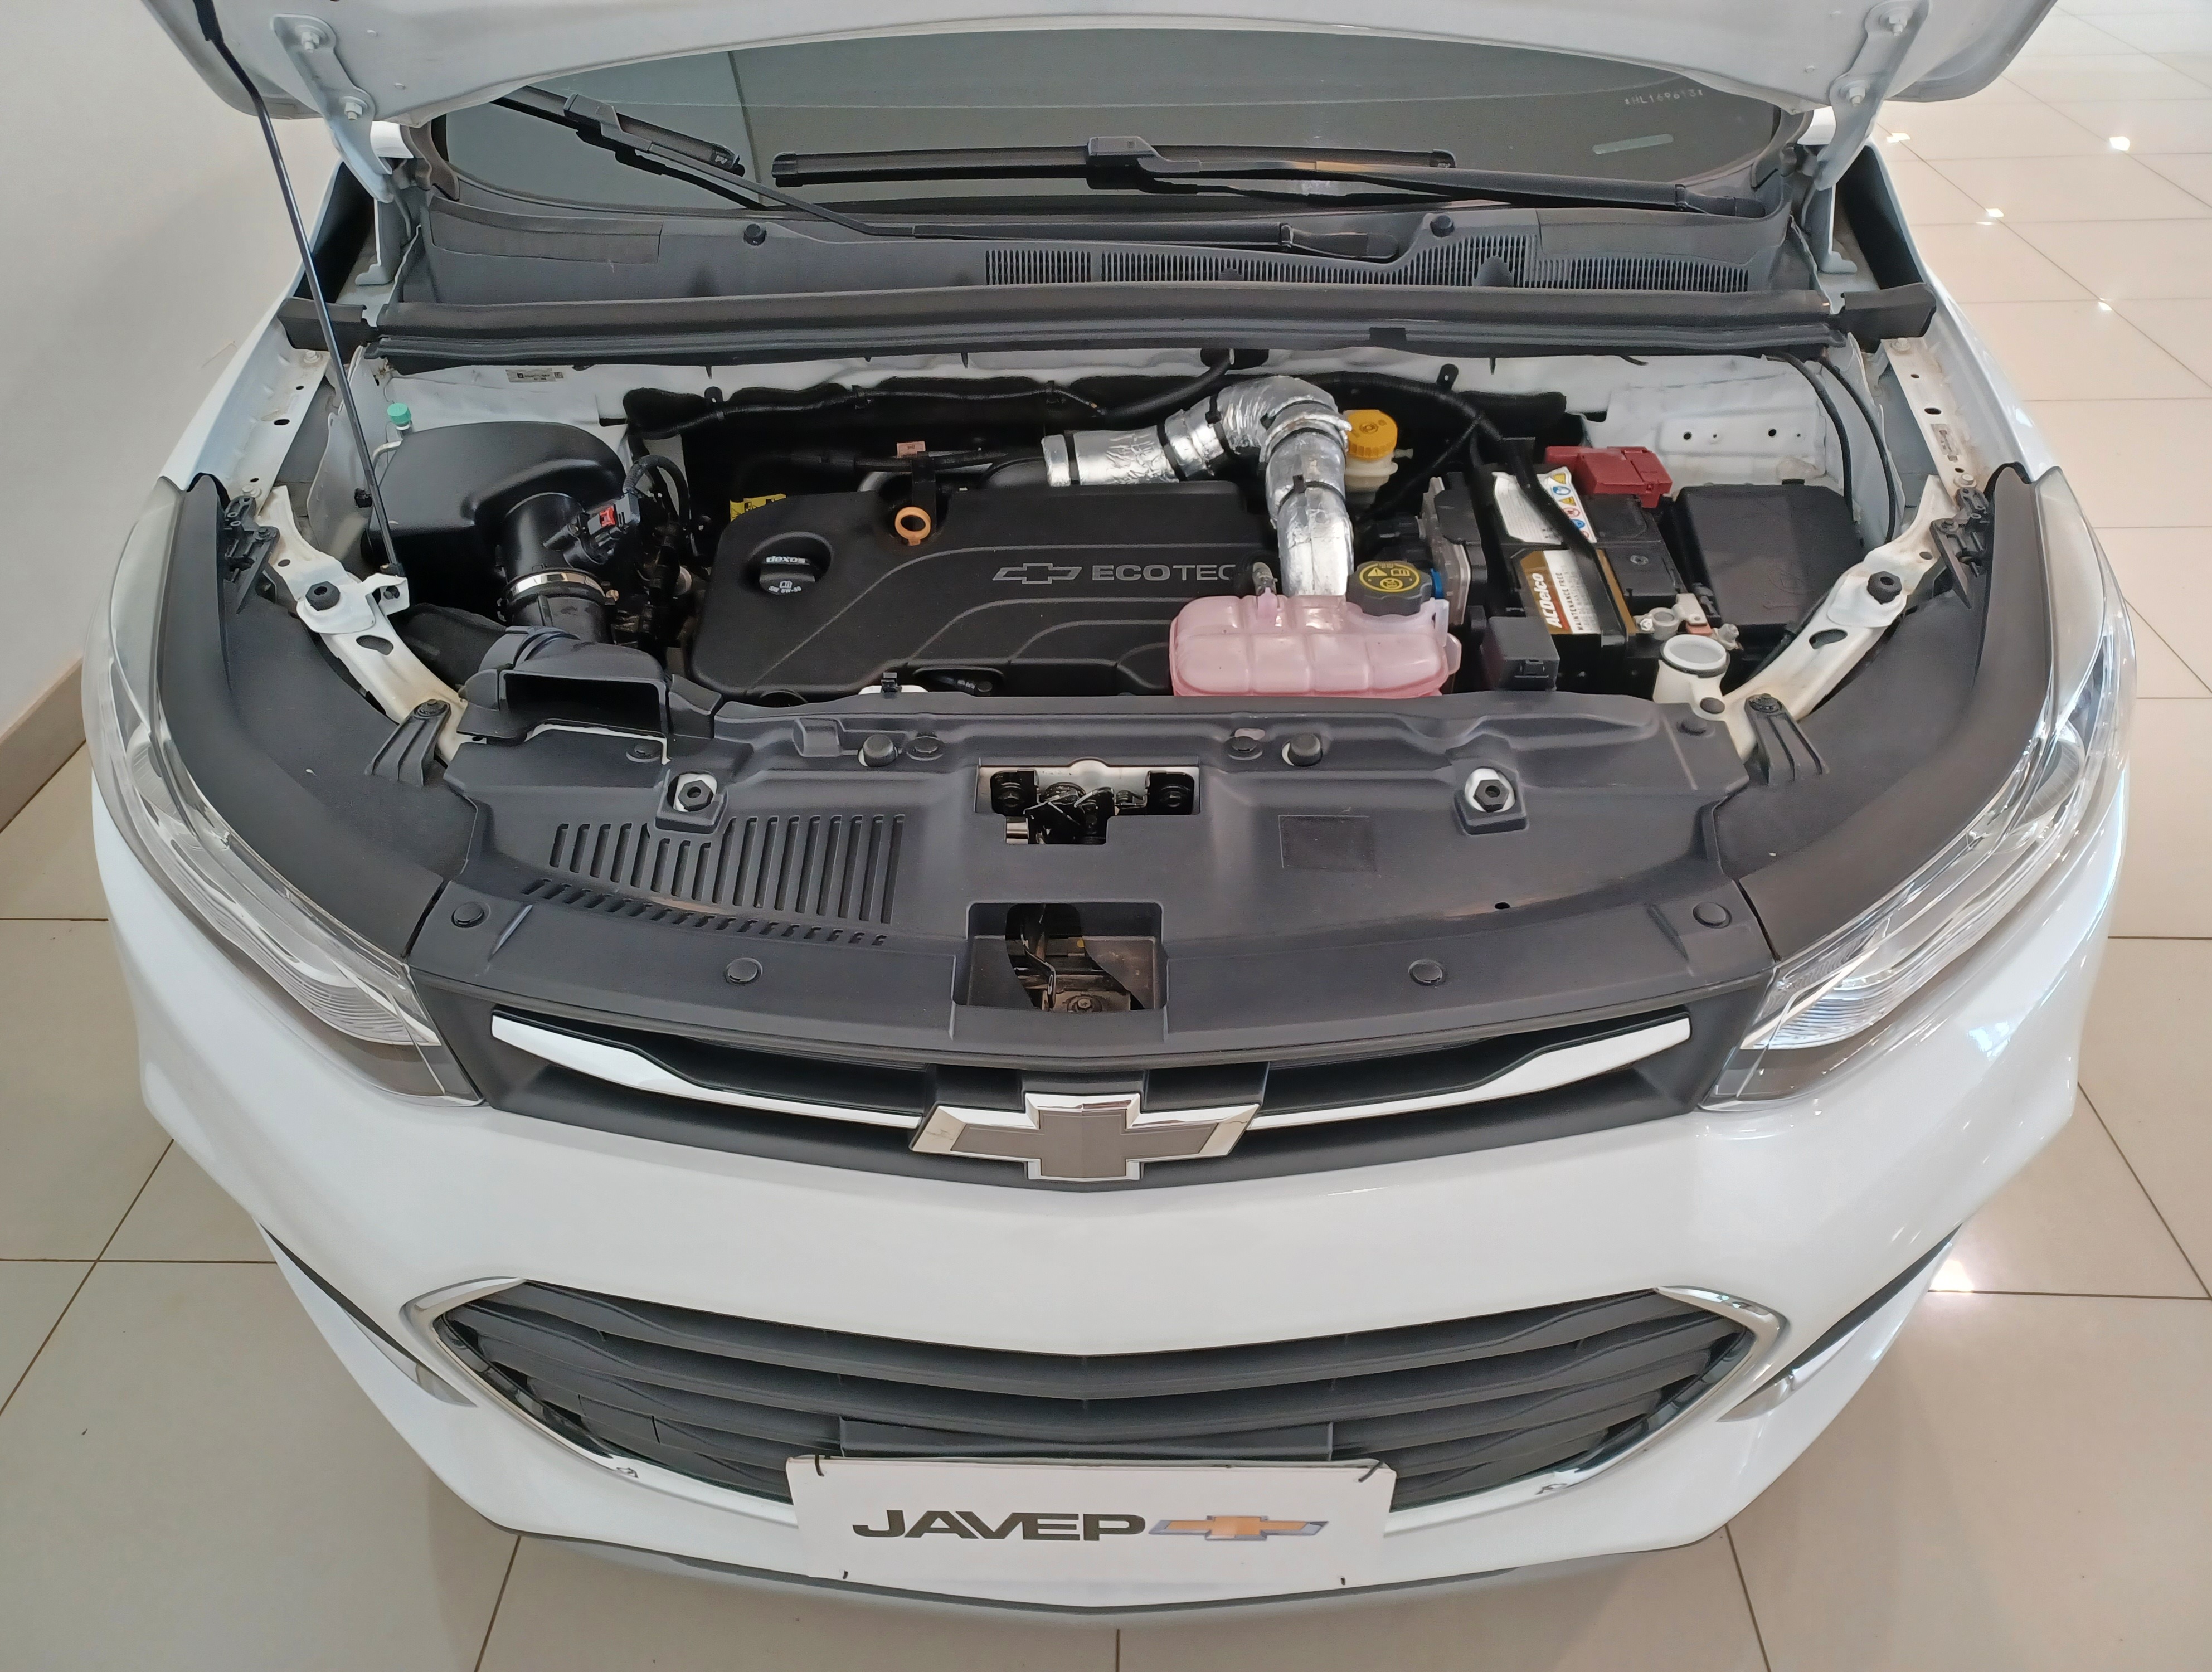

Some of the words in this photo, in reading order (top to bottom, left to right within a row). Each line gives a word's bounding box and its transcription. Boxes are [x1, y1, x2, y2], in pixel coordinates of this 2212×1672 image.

[1555, 572, 1567, 587] FREE
[1532, 573, 1562, 629] ACDelco
[1562, 589, 1584, 630] MAINTENANCE
[852, 1509, 1146, 1542] JAVEP
